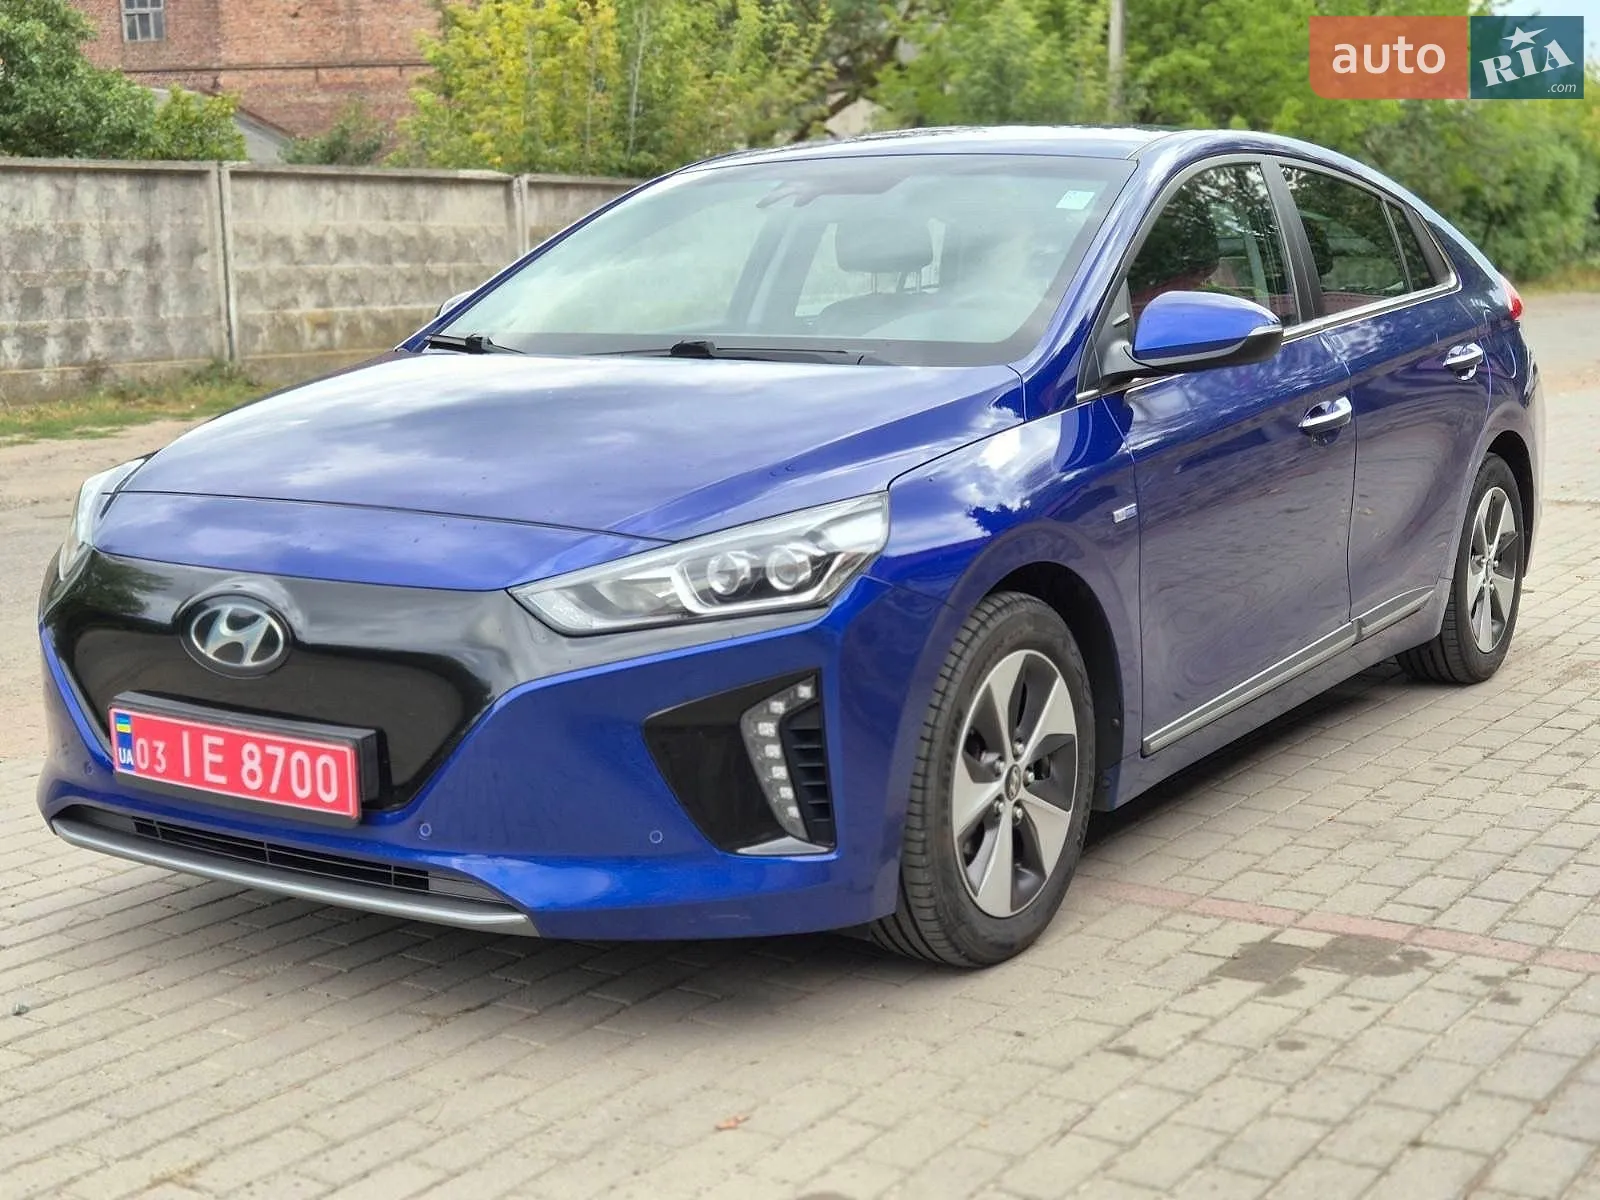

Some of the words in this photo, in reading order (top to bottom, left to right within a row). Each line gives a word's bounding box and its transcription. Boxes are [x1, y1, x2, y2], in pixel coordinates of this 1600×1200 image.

[118, 747, 134, 765] UA
[136, 738, 167, 773] 03
[182, 731, 227, 784] IE
[241, 743, 338, 803] 8700
